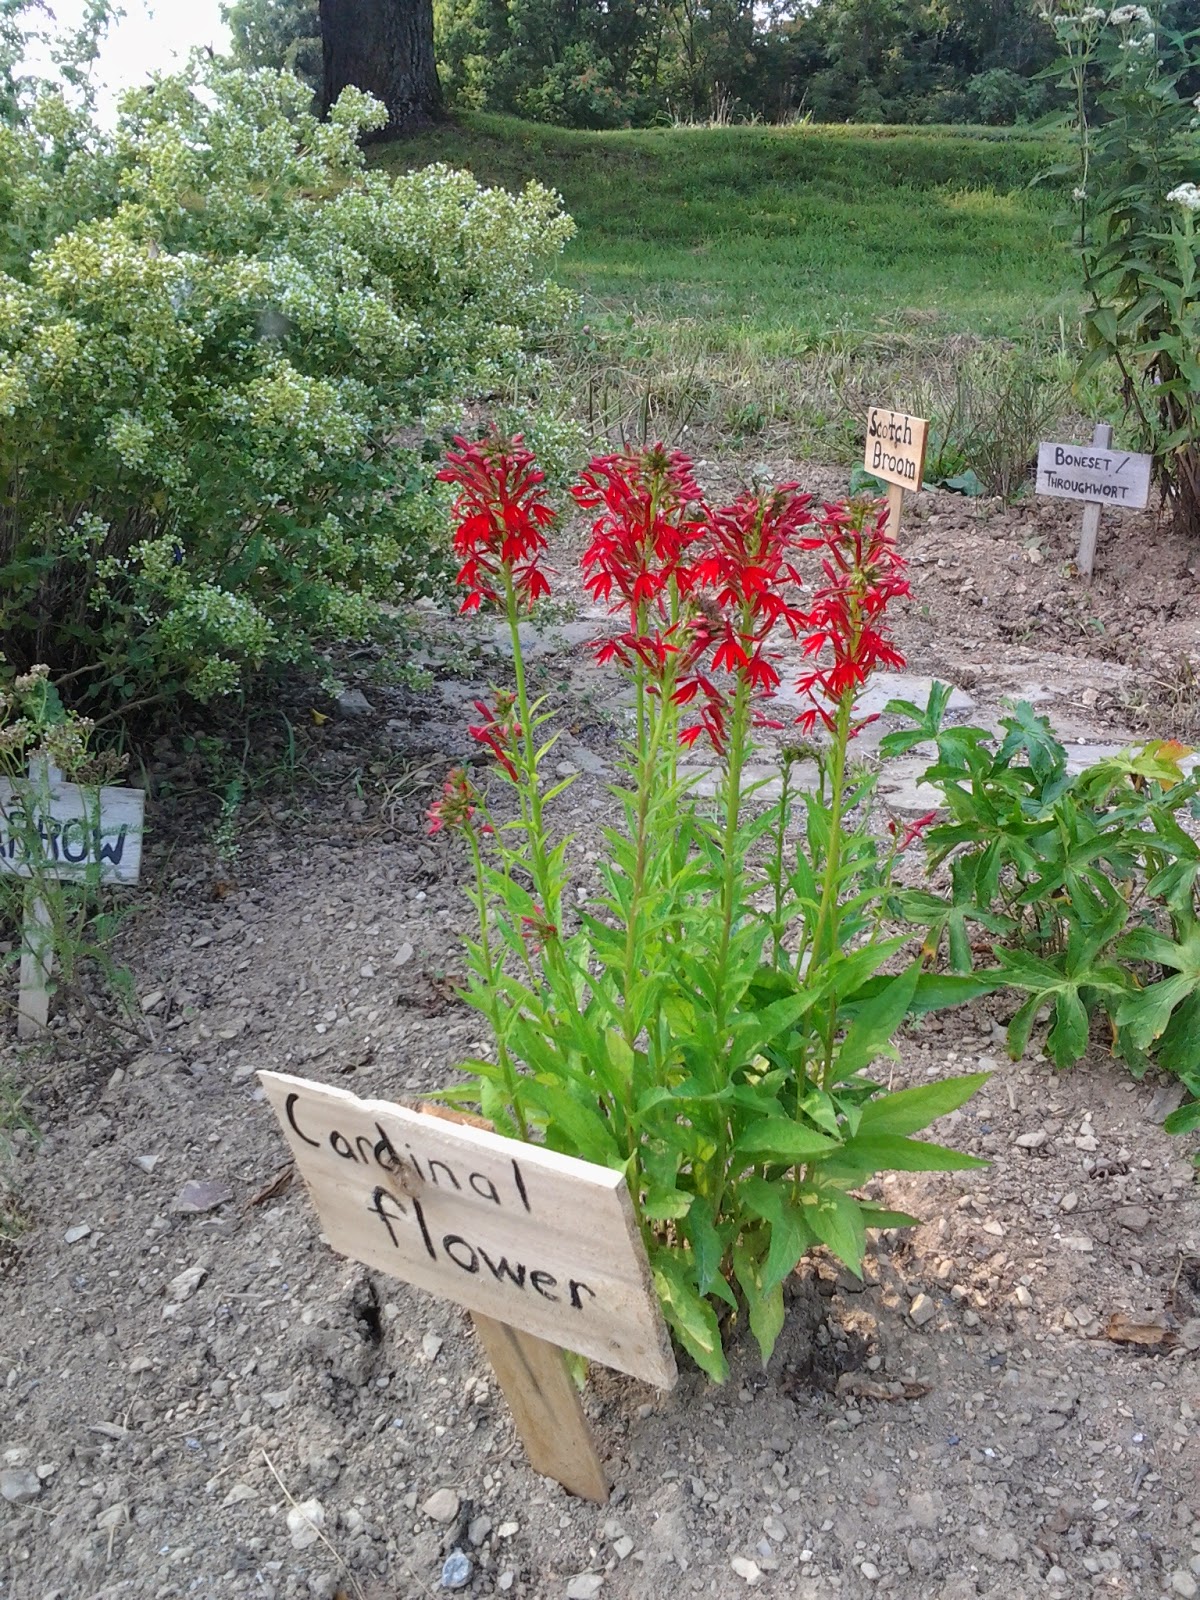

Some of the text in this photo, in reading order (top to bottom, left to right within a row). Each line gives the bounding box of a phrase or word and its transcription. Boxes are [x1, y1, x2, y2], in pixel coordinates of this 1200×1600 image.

[869, 409, 912, 445] Scotch
[872, 440, 916, 480] Broom
[1043, 470, 1129, 499] THROUGHWORT
[285, 1093, 531, 1213] Cardinal
